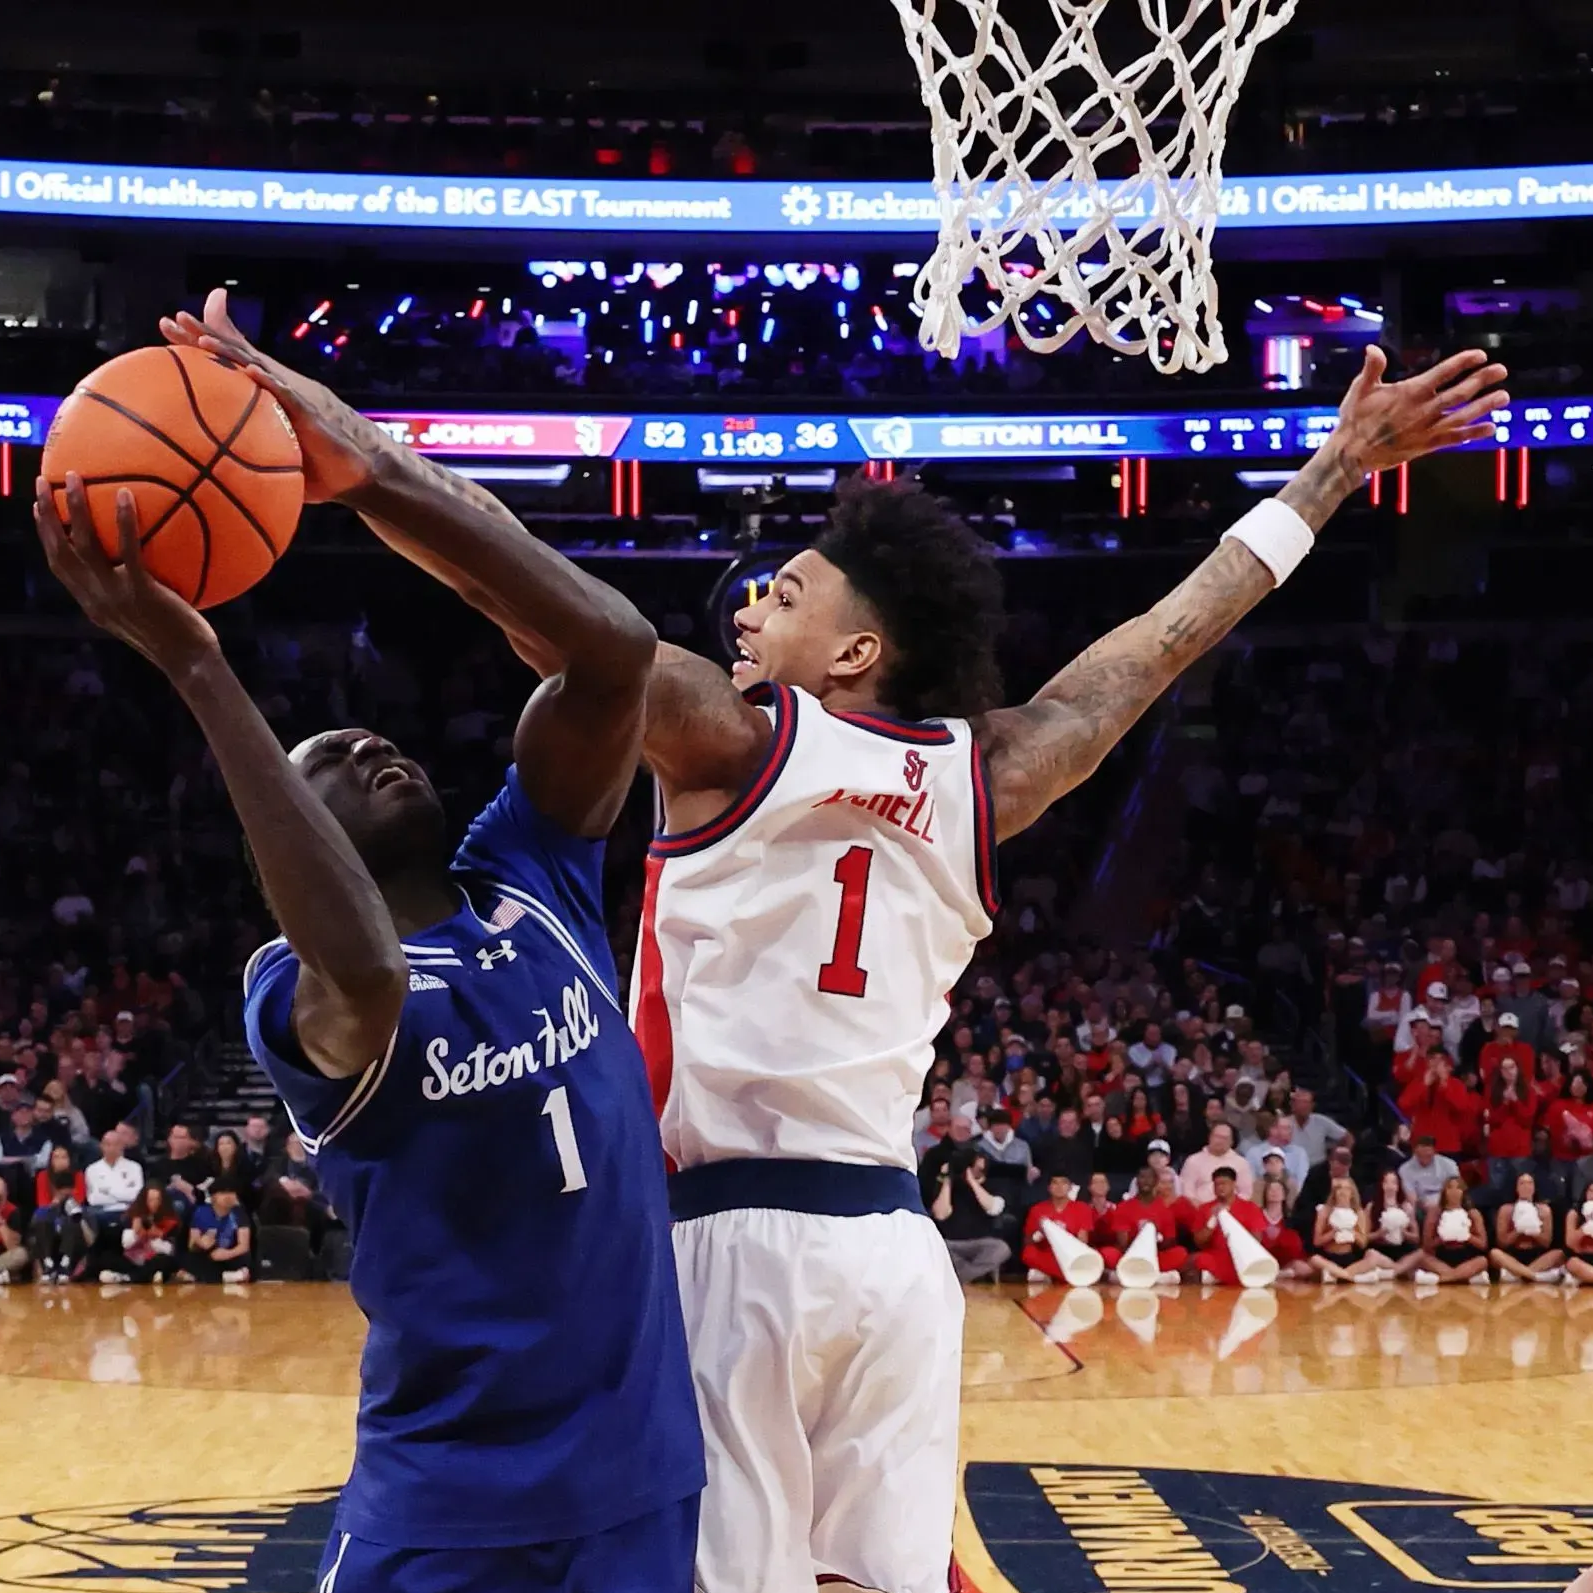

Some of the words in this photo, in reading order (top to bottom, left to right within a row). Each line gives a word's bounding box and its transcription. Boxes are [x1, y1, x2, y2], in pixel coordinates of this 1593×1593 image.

[15, 171, 113, 203] Official
[118, 177, 257, 208] Healthcare
[263, 181, 359, 212] Partner
[363, 184, 394, 213] of
[395, 185, 438, 214] the
[444, 187, 496, 216] BIG
[502, 188, 577, 216] EAST
[580, 189, 732, 218] Tournament
[1272, 182, 1368, 213] Official
[1373, 180, 1511, 211] Healthcare
[419, 422, 535, 446] JOHN'S
[644, 421, 687, 449] 52
[701, 432, 784, 457] 11:03
[795, 422, 838, 449] 36
[941, 424, 1044, 446] SETON
[1049, 423, 1127, 446] HALL
[1270, 432, 1282, 450] 1
[818, 845, 874, 998] 1
[422, 1037, 540, 1101] Seton
[541, 1085, 588, 1194] 1
